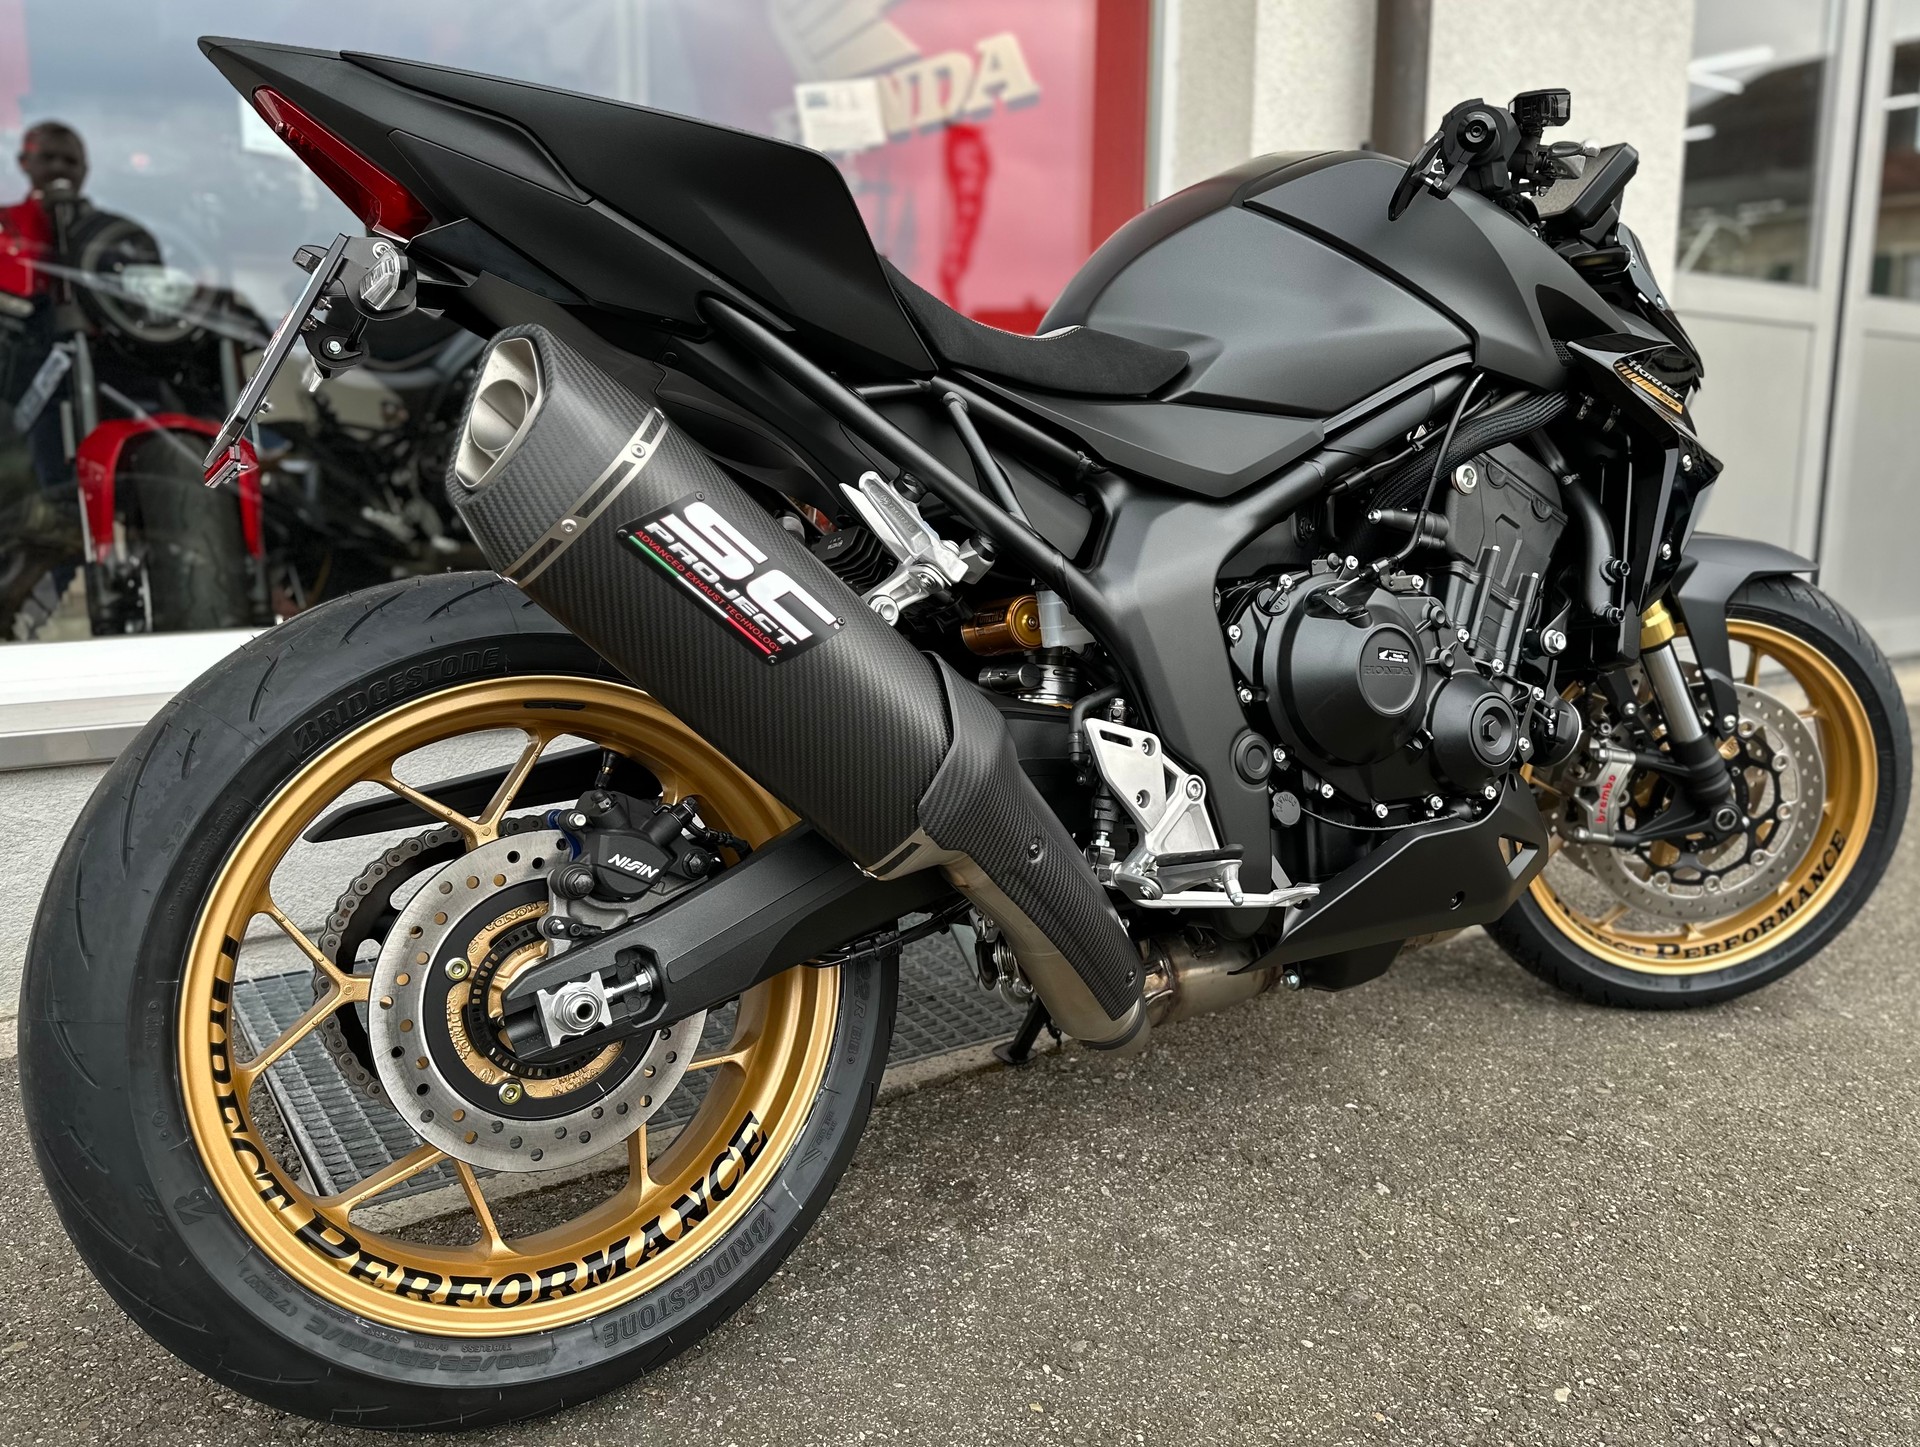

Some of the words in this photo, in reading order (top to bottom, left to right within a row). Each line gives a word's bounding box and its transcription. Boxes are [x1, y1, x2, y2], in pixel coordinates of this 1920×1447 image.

[876, 31, 1040, 141] NDA
[634, 529, 686, 573] ADVANCED
[685, 570, 725, 605] EXHAUST
[724, 603, 783, 653] TECHNOLOGY
[644, 521, 798, 646] PROJECT
[291, 646, 501, 755] BRIDGESTONE
[1363, 664, 1414, 677] HONDA
[1595, 774, 1616, 824] brembo
[484, 902, 540, 931] HONDA
[1655, 829, 1846, 960] PERFORMANCE
[294, 1110, 768, 1308] PERFORMANCE
[603, 1208, 776, 1349] BRIDGESTONE
